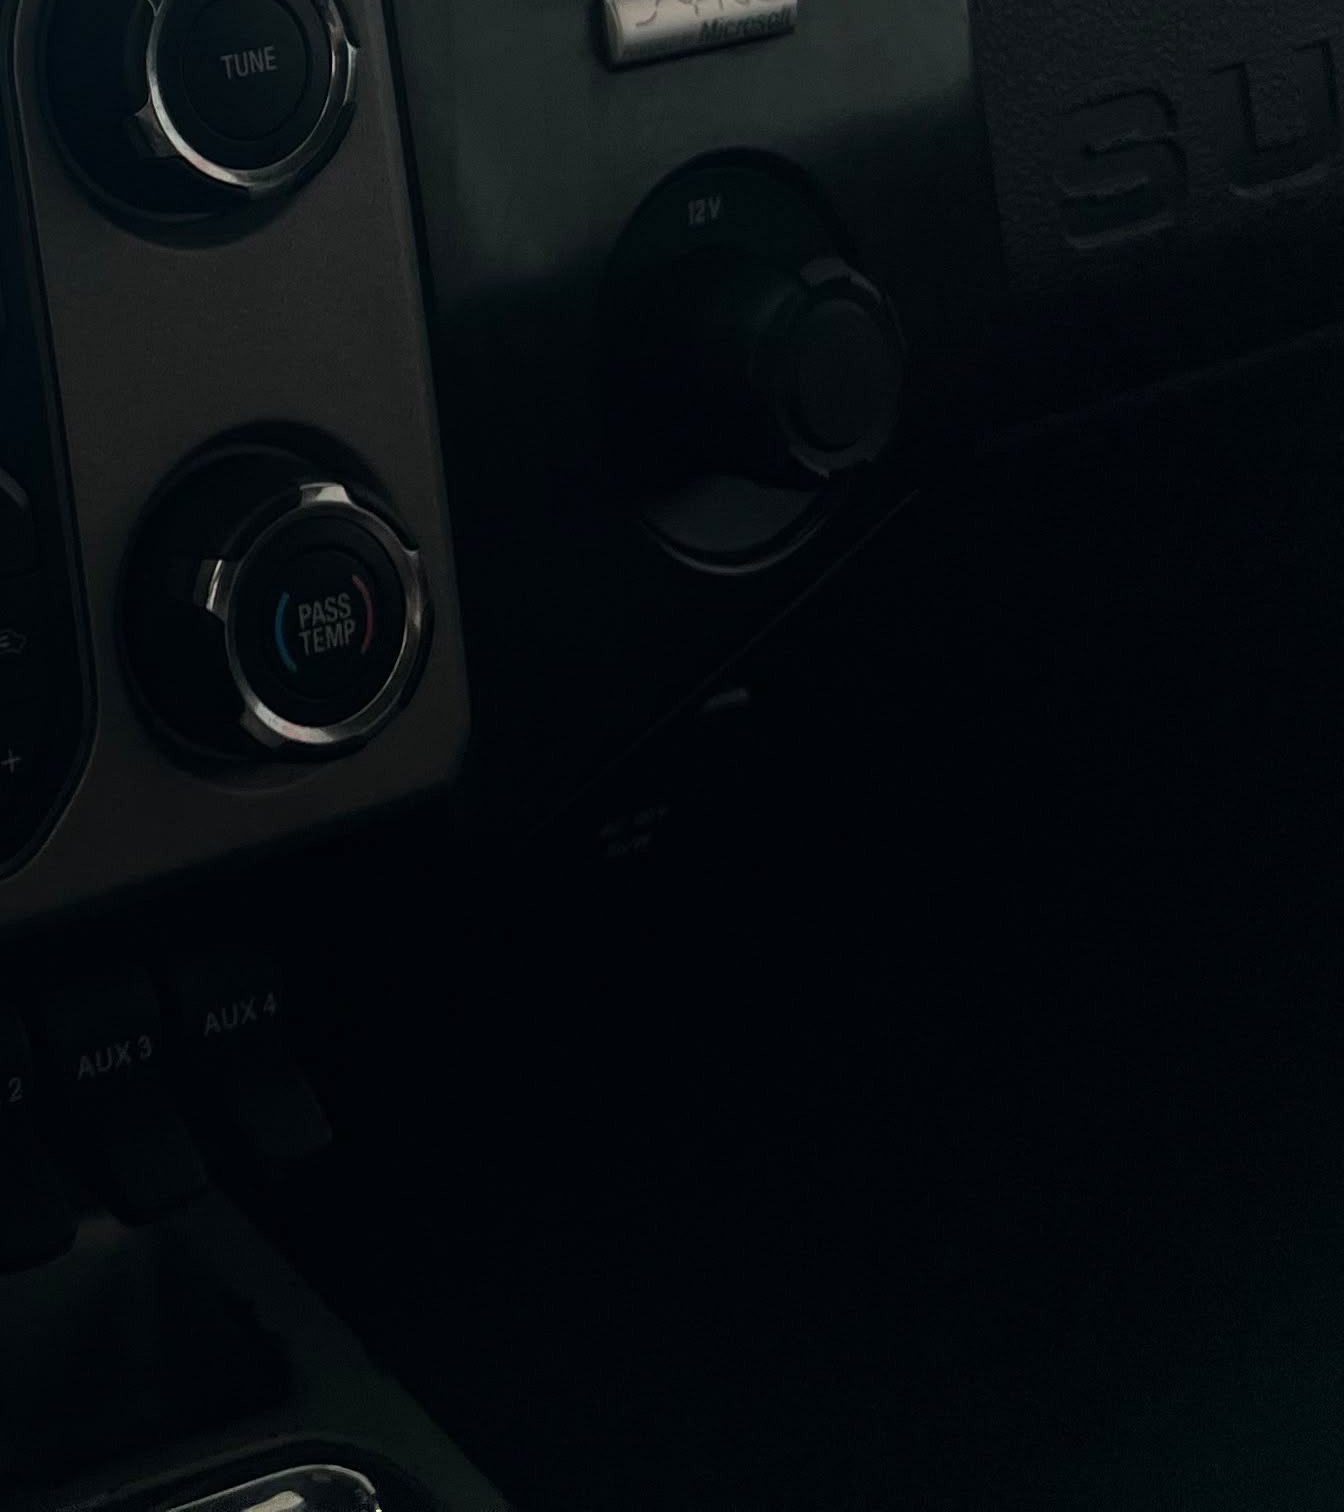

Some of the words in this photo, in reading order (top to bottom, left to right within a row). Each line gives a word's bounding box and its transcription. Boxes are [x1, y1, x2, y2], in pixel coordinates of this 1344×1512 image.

[219, 45, 279, 80] TUNE
[687, 195, 723, 226] 12V
[297, 591, 353, 630] PASS
[297, 619, 357, 657] TEMP
[202, 998, 258, 1038] AUX
[261, 991, 279, 1017] 4
[76, 1040, 134, 1081] AUX
[137, 1034, 154, 1061] 3
[8, 1076, 25, 1103] 2
